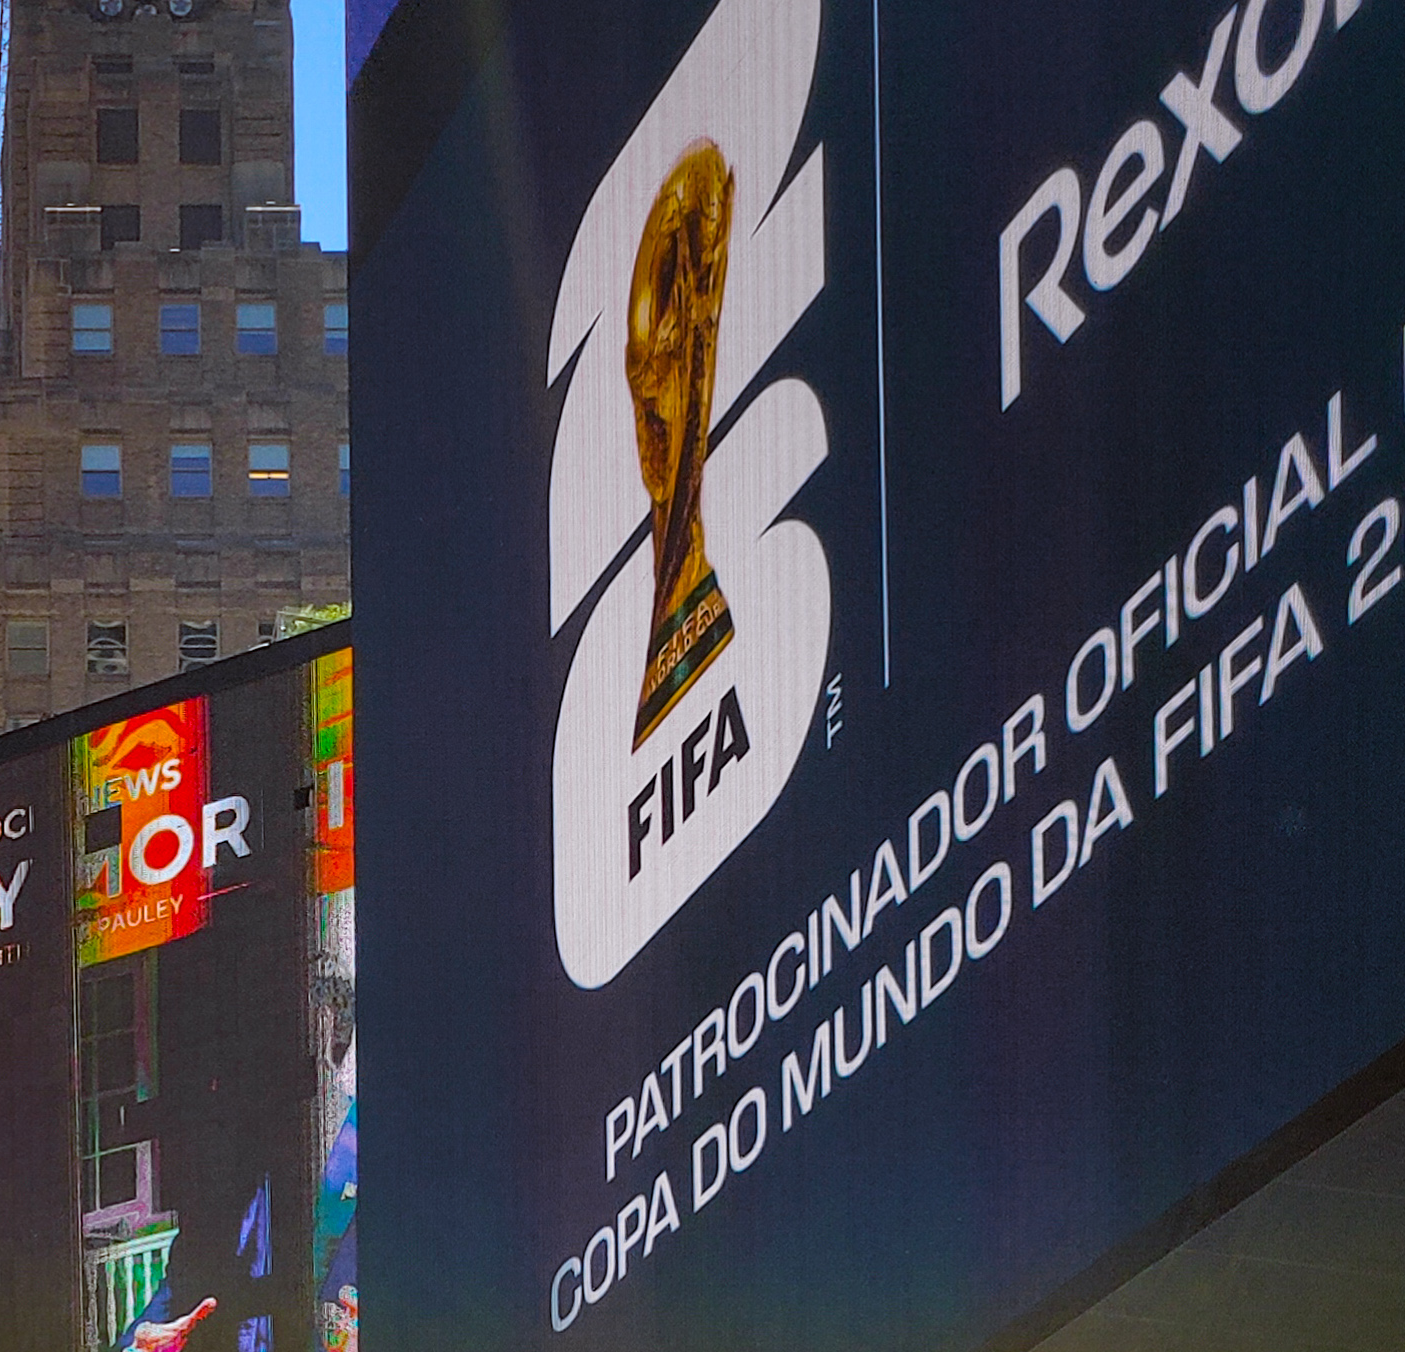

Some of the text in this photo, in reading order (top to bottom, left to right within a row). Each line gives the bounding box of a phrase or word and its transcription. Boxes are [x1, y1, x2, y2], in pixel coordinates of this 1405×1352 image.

[1000, 0, 1364, 412] Rexo
[604, 390, 1378, 1184] PATROCINADOR OFICIAL
[627, 685, 750, 883] FIFA
[827, 672, 843, 749] TM
[97, 894, 184, 932] PAULEY
[549, 1177, 679, 1334] COPA
[692, 1088, 767, 1213] DO
[781, 860, 1012, 1133] MUNDO
[1032, 756, 1134, 909] DA
[1153, 582, 1324, 798] FIFA
